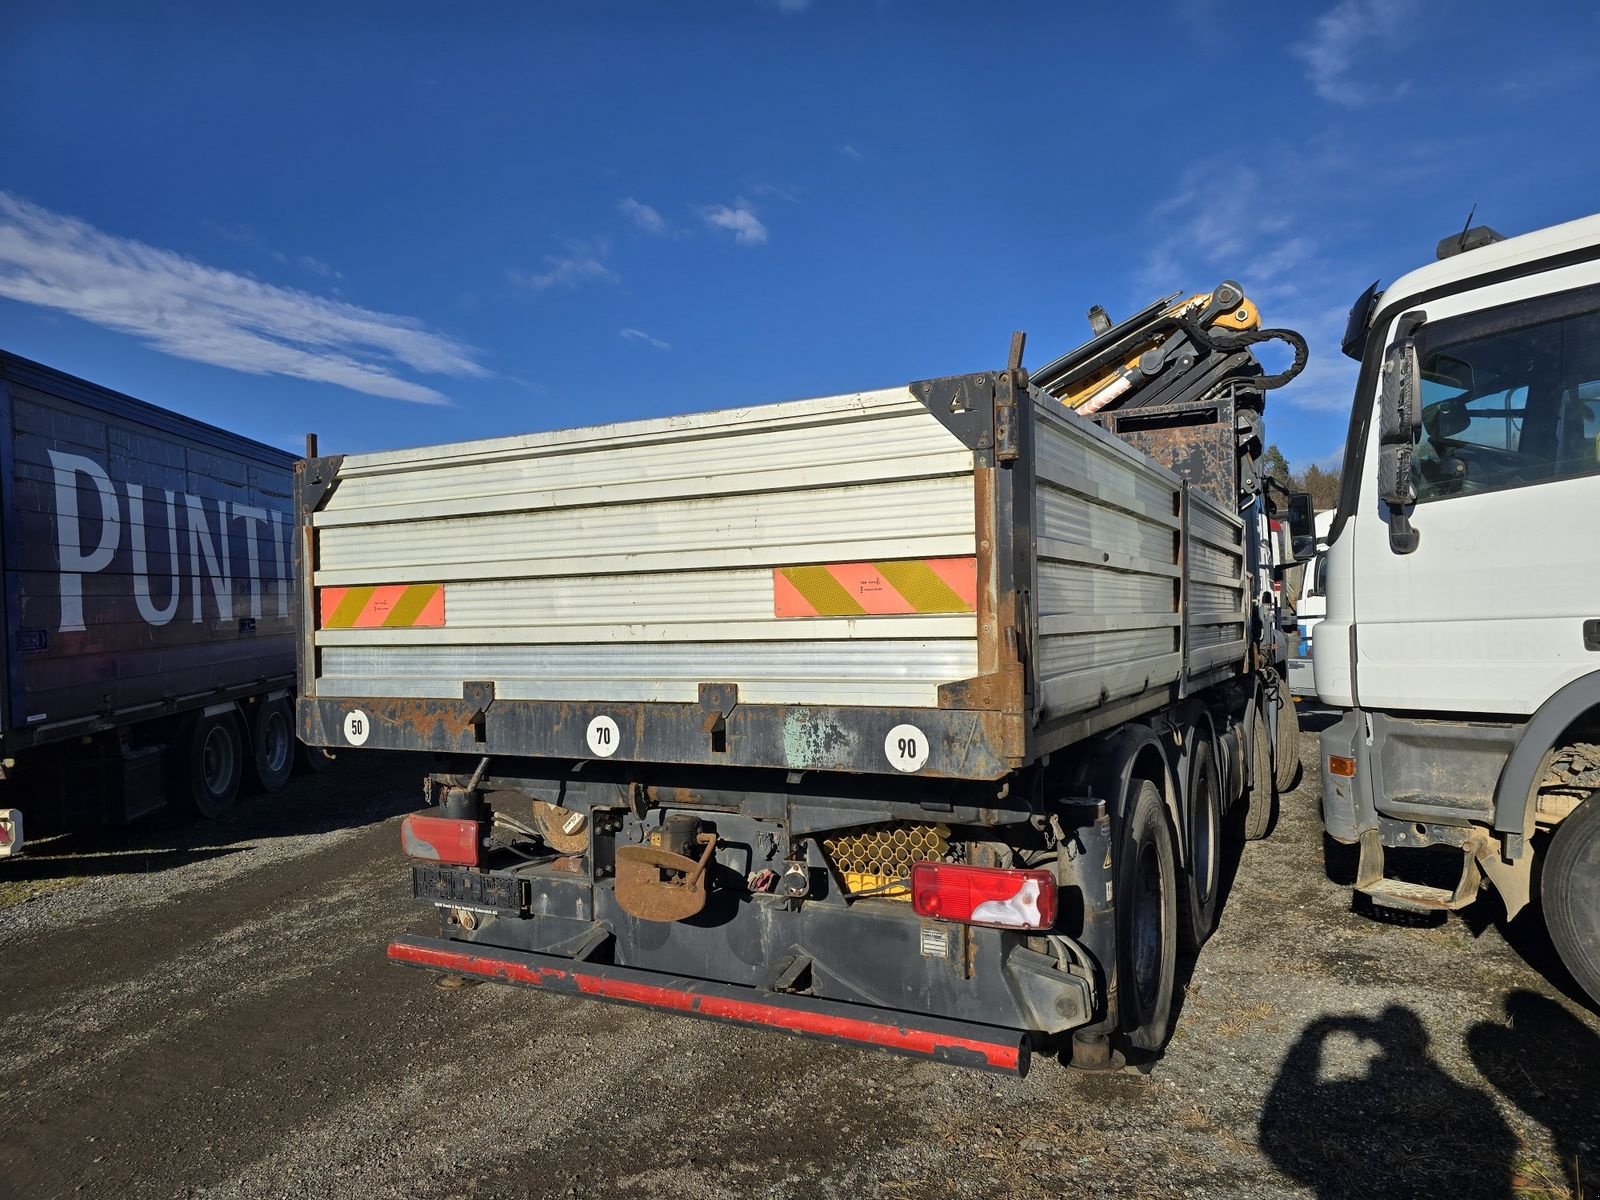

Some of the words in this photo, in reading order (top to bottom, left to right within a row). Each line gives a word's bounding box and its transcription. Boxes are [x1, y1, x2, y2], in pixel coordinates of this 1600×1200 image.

[47, 449, 295, 633] PUNTI
[351, 719, 363, 736] 50
[596, 727, 611, 745] 70
[898, 738, 917, 759] 90
